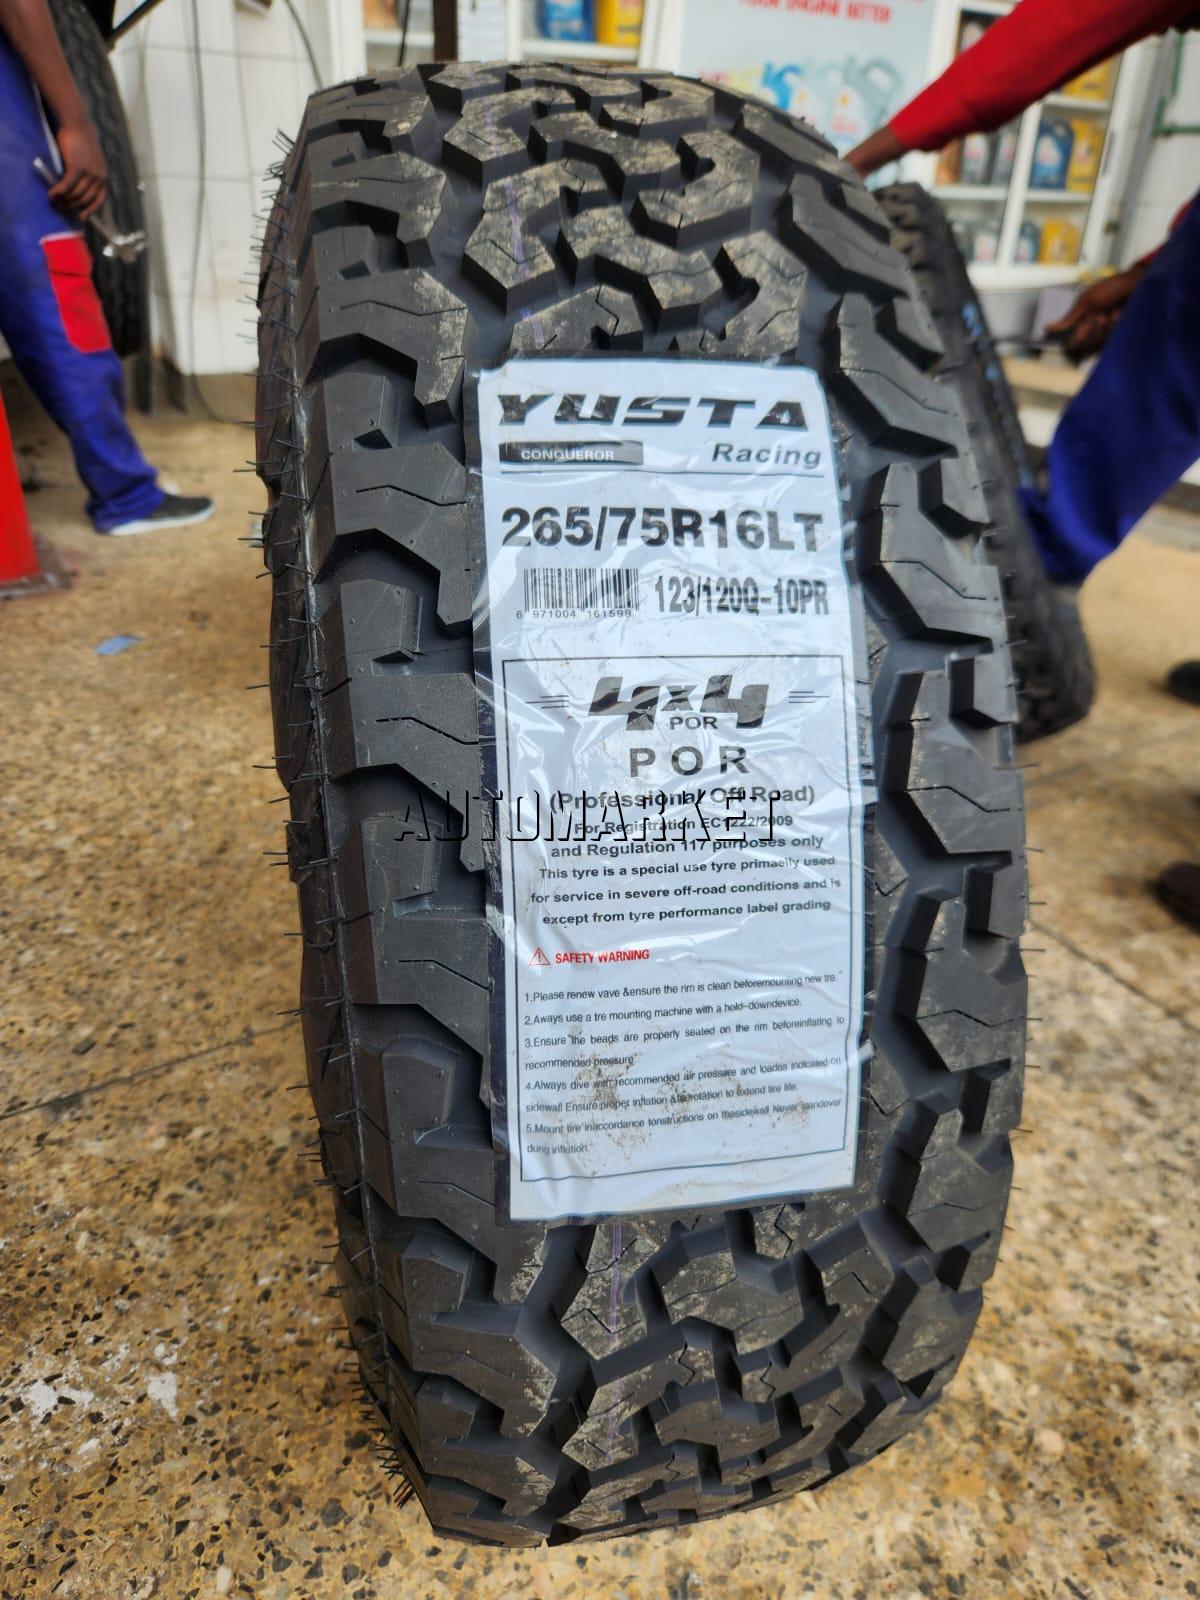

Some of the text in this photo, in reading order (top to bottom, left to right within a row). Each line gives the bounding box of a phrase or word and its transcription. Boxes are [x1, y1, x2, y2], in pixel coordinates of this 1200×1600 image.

[498, 394, 808, 431] YUSTA
[521, 449, 615, 462] CONQUEROR
[712, 443, 822, 469] Racing
[502, 506, 823, 551] 265/75R16LT
[655, 576, 830, 616] 123/120Q-10PR
[516, 611, 523, 619] 6
[533, 610, 576, 618] 971004
[669, 716, 718, 730] POR
[710, 787, 745, 803] Off
[551, 835, 823, 857] and Regulation 117 purposes only
[539, 868, 568, 879] This
[572, 867, 599, 880] tyre
[604, 866, 615, 876] is
[619, 867, 627, 875] a
[631, 863, 679, 877] special
[684, 863, 707, 872] use
[711, 861, 737, 873] tyre
[803, 856, 835, 866] used
[531, 878, 841, 903] for service in severe off-road conditions and is
[543, 900, 831, 925] except from tyre performance label grading
[555, 949, 650, 964] SAFETY WARNING
[566, 990, 595, 999] renew
[664, 984, 678, 994] the
[681, 983, 695, 992] rim
[698, 982, 705, 991] is
[707, 980, 731, 990] clean
[805, 975, 821, 983] new
[566, 1014, 583, 1022] use
[586, 1014, 592, 1022] a
[609, 1009, 651, 1020] mounting
[655, 1006, 692, 1017] machine
[695, 1004, 713, 1015] with
[716, 1005, 721, 1013] a
[571, 1034, 586, 1044] the
[590, 1033, 619, 1044] beads
[623, 1032, 639, 1041] are
[644, 1029, 680, 1042] properly
[685, 1026, 715, 1037] seated
[719, 1026, 731, 1034] on
[736, 1023, 749, 1032] the
[754, 1022, 767, 1031] rim
[525, 1057, 591, 1070] recommended
[525, 1080, 567, 1091] 4.Always
[571, 1079, 589, 1089] dive
[615, 1073, 680, 1086] recommended
[684, 1071, 695, 1080] air
[698, 1068, 736, 1081] pressure
[740, 1065, 756, 1075] and
[791, 1057, 827, 1070] indicated
[566, 1101, 598, 1112] Ensure
[633, 1096, 668, 1107] inflation
[726, 1088, 734, 1097] to
[768, 1083, 781, 1093] tire
[567, 1123, 581, 1132] tire
[707, 1112, 718, 1120] on
